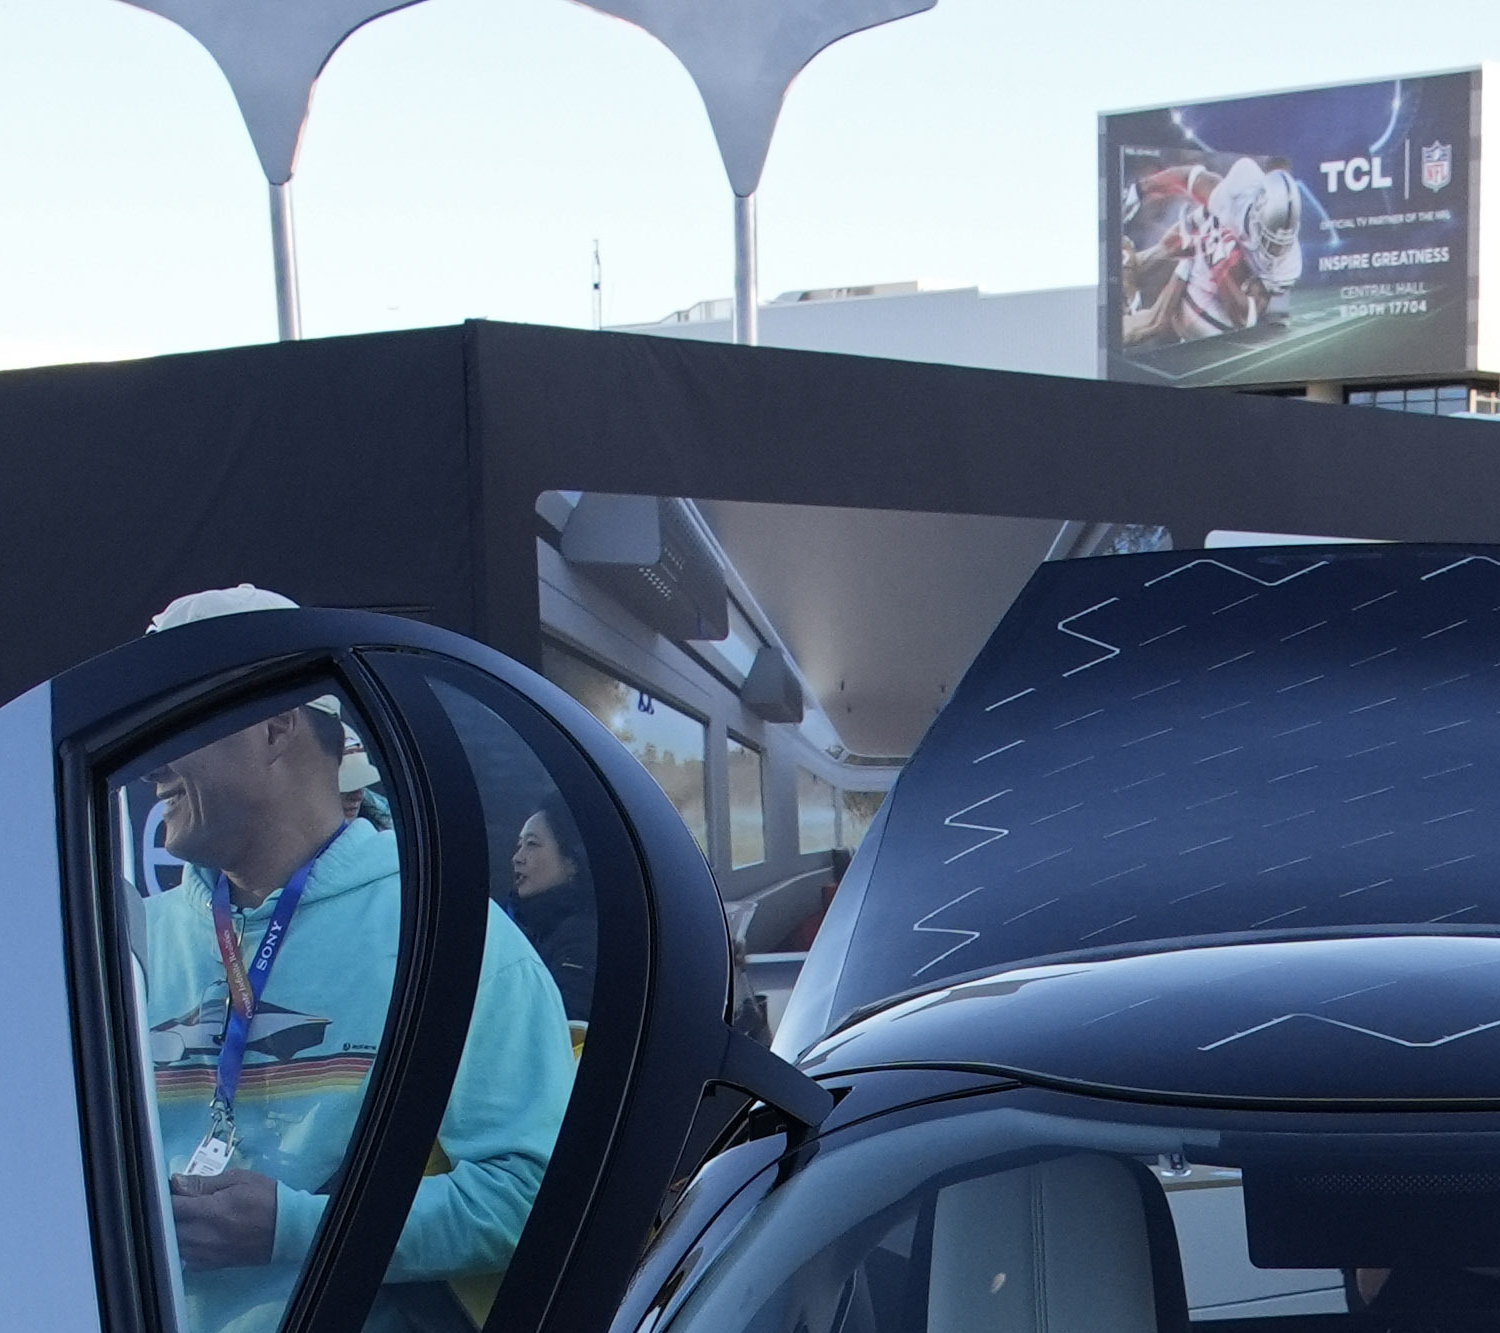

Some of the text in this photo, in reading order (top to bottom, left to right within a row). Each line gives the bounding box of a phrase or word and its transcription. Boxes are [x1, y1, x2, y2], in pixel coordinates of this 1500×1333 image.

[1320, 157, 1393, 193] TCL
[1357, 217, 1367, 227] TV
[1368, 214, 1404, 226] PARTNER
[1319, 247, 1450, 272] INSPIRE GREATNESS
[1340, 282, 1428, 299] CENTRAL HALL
[1340, 300, 1428, 318] BOOTH 17704
[256, 920, 283, 971] SONY
